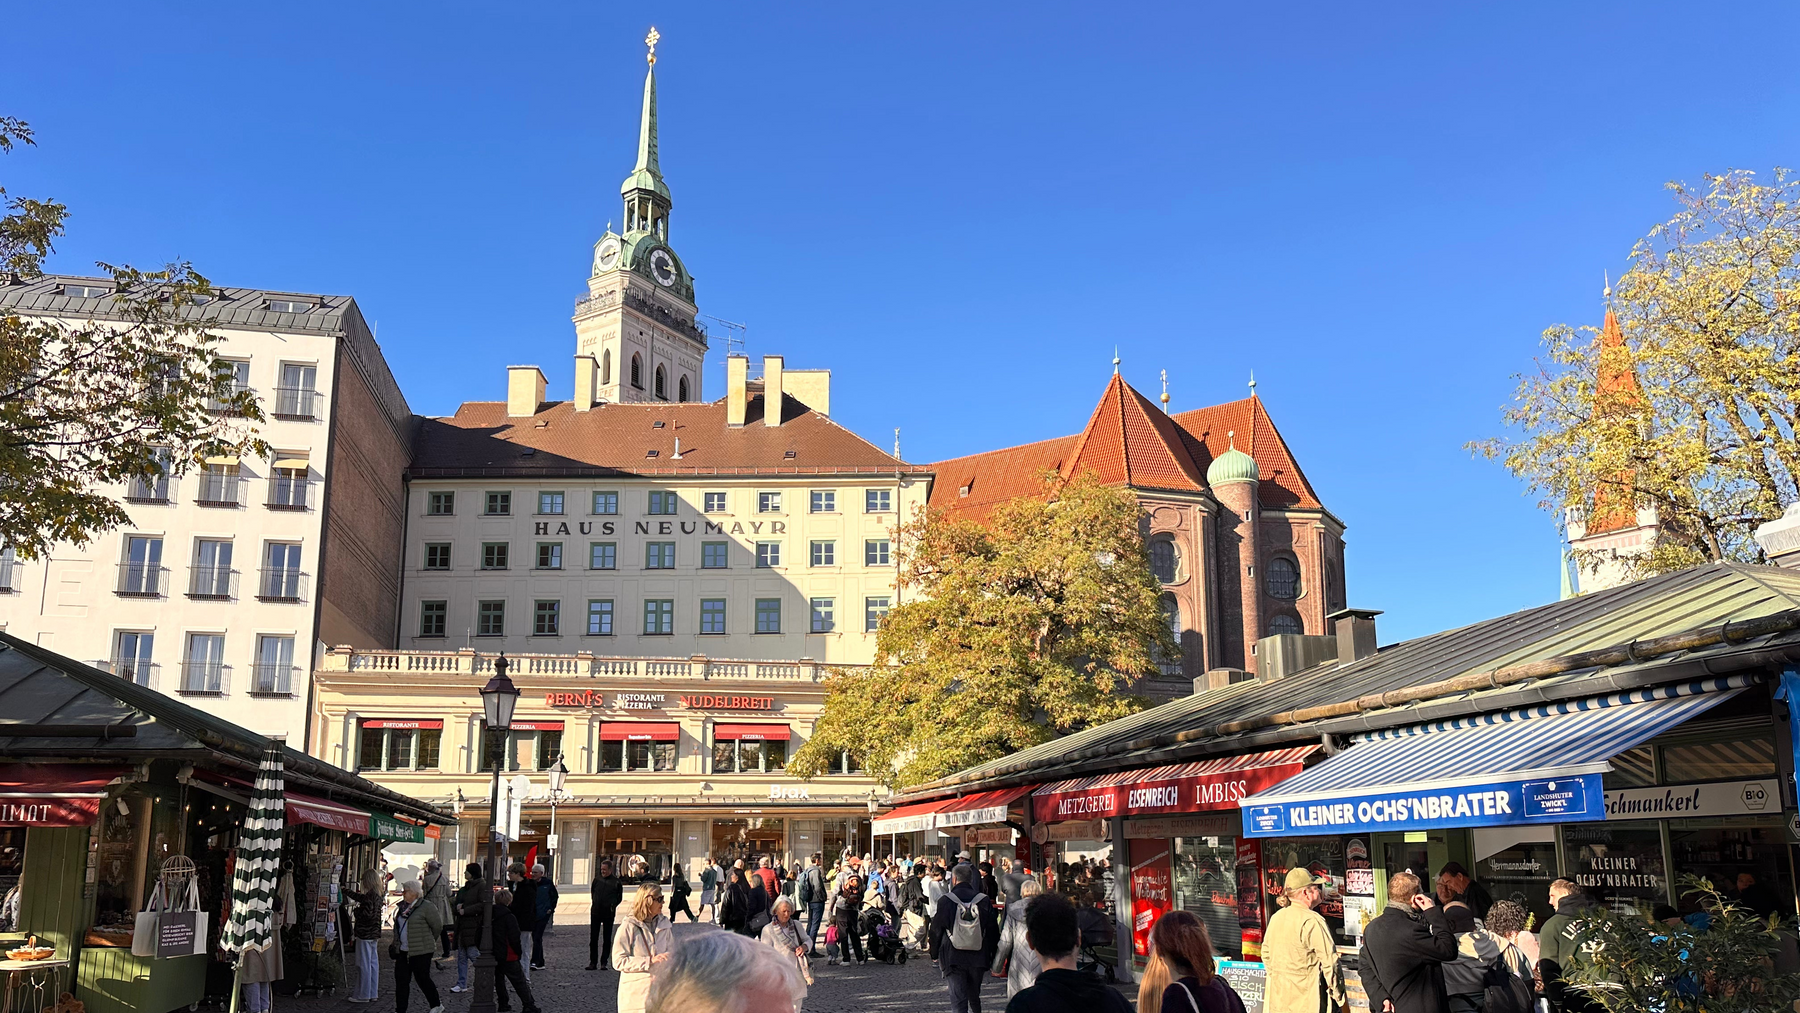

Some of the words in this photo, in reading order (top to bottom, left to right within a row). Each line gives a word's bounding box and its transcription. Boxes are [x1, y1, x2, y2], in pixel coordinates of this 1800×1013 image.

[534, 521, 615, 535] HAUS
[635, 521, 786, 535] NEUMAYR
[616, 694, 665, 702] RISTORANTE
[680, 695, 774, 710] NUDELBRETT
[616, 702, 652, 710] PIZZERIA
[770, 785, 810, 799] Brax
[1128, 786, 1178, 809] EISENREICH
[1196, 780, 1247, 805] IMBISS
[1058, 793, 1115, 815] METZGEREI
[1290, 804, 1355, 827] KLEINER
[1358, 790, 1512, 823] OCHS'NBRATER
[1603, 787, 1700, 816] Schmankerl
[0, 804, 51, 821] IMAT
[1590, 857, 1637, 871] KLEINER
[1576, 873, 1658, 888] OCHS'NBRATER
[1222, 967, 1266, 978] HAUSGEMACHTE
[1230, 981, 1265, 992] EISCH-
